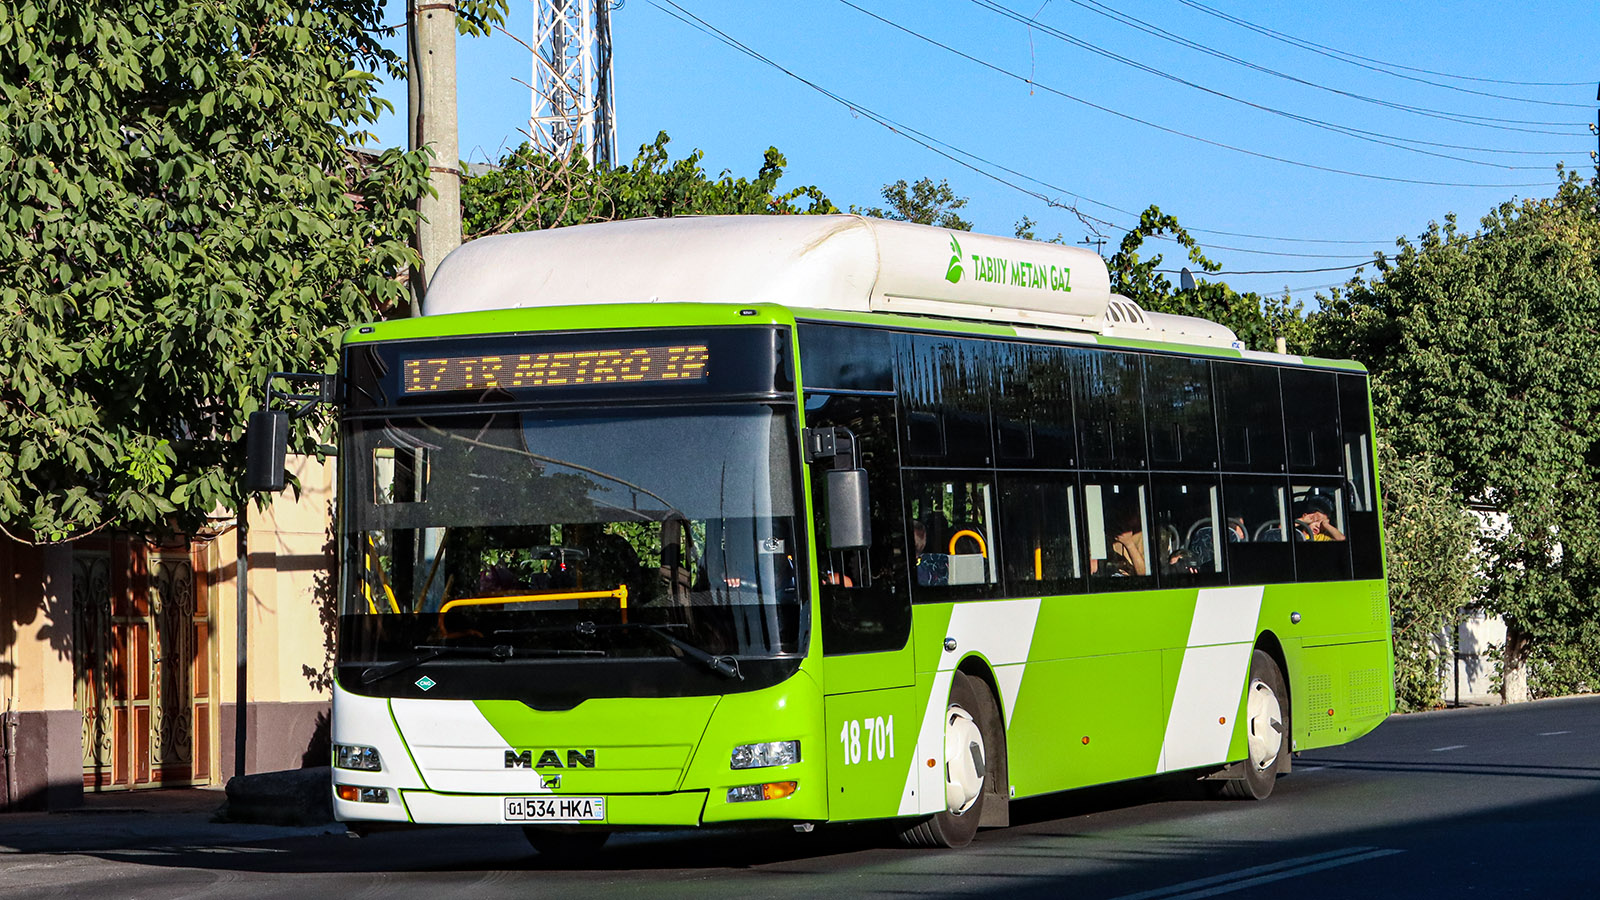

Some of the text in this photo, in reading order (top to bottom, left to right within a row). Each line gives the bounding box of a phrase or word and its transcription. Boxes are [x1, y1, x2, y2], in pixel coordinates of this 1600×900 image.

[972, 255, 1072, 292] TABIIY METAN GAZ
[407, 360, 448, 391] 17
[513, 348, 651, 385] METRO
[840, 714, 894, 765] 18 701
[504, 749, 596, 768] MAN
[508, 800, 593, 817] 01 534 HKA
